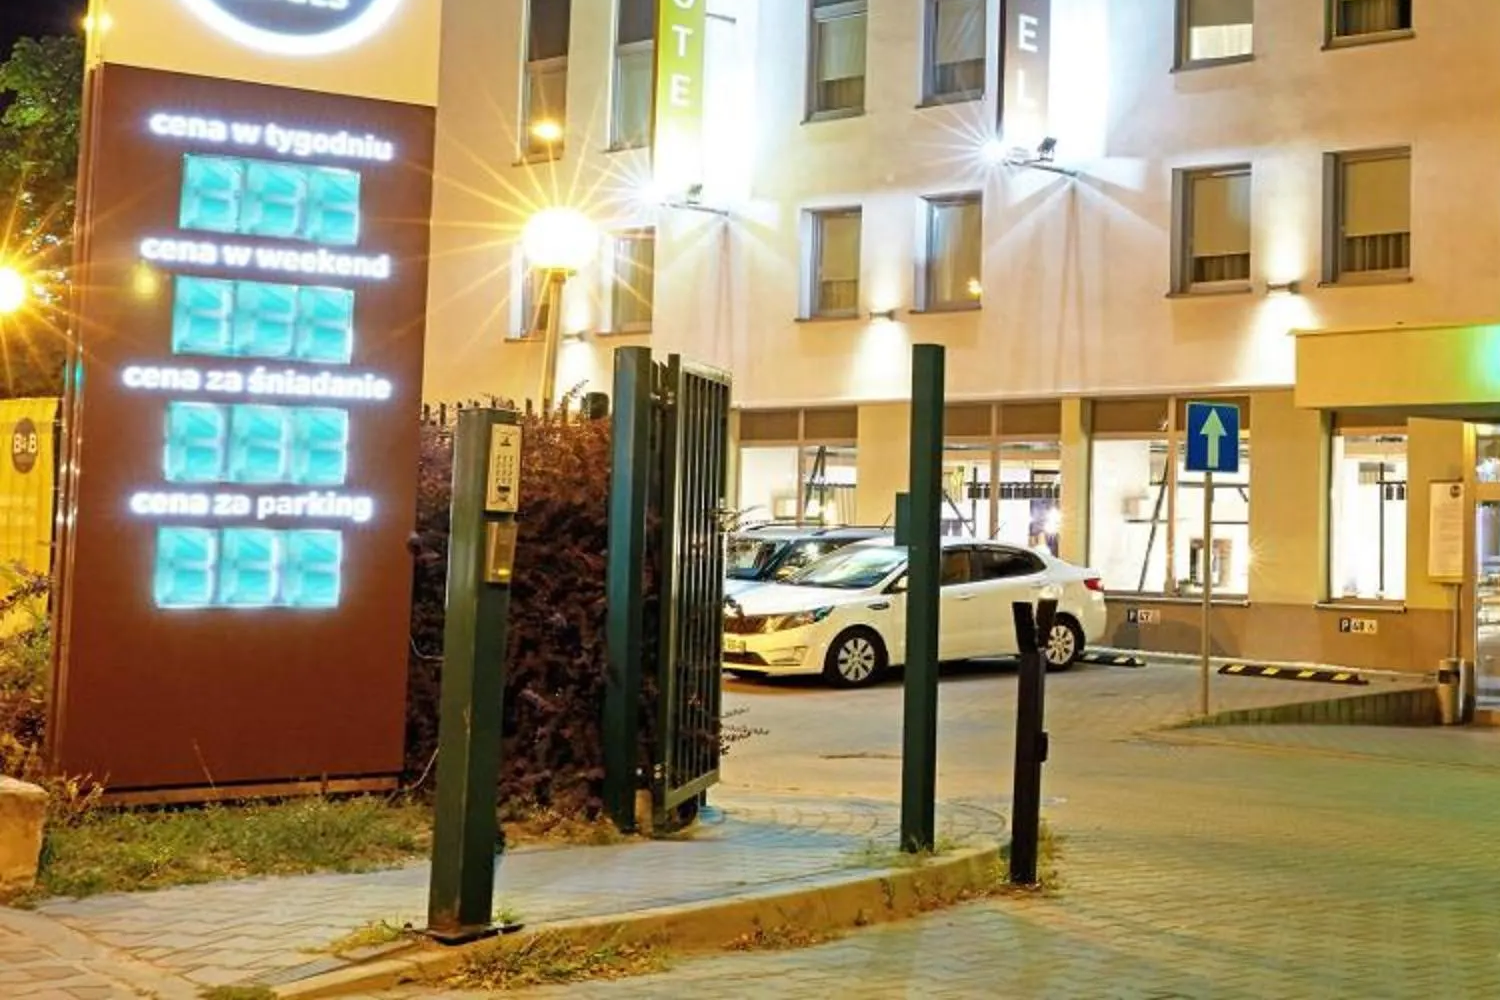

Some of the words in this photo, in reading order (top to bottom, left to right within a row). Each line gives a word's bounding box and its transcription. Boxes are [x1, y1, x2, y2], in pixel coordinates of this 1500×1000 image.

[149, 112, 227, 144] cena
[231, 119, 260, 146] w
[264, 121, 394, 162] tygodniu
[140, 236, 218, 266] cena
[222, 242, 252, 268] w
[256, 245, 390, 278] weekend
[123, 364, 199, 392] cena
[206, 369, 243, 393] za
[247, 365, 392, 400] śniadanie
[130, 490, 208, 516] cena
[213, 492, 250, 516] za
[257, 491, 374, 522] parking
